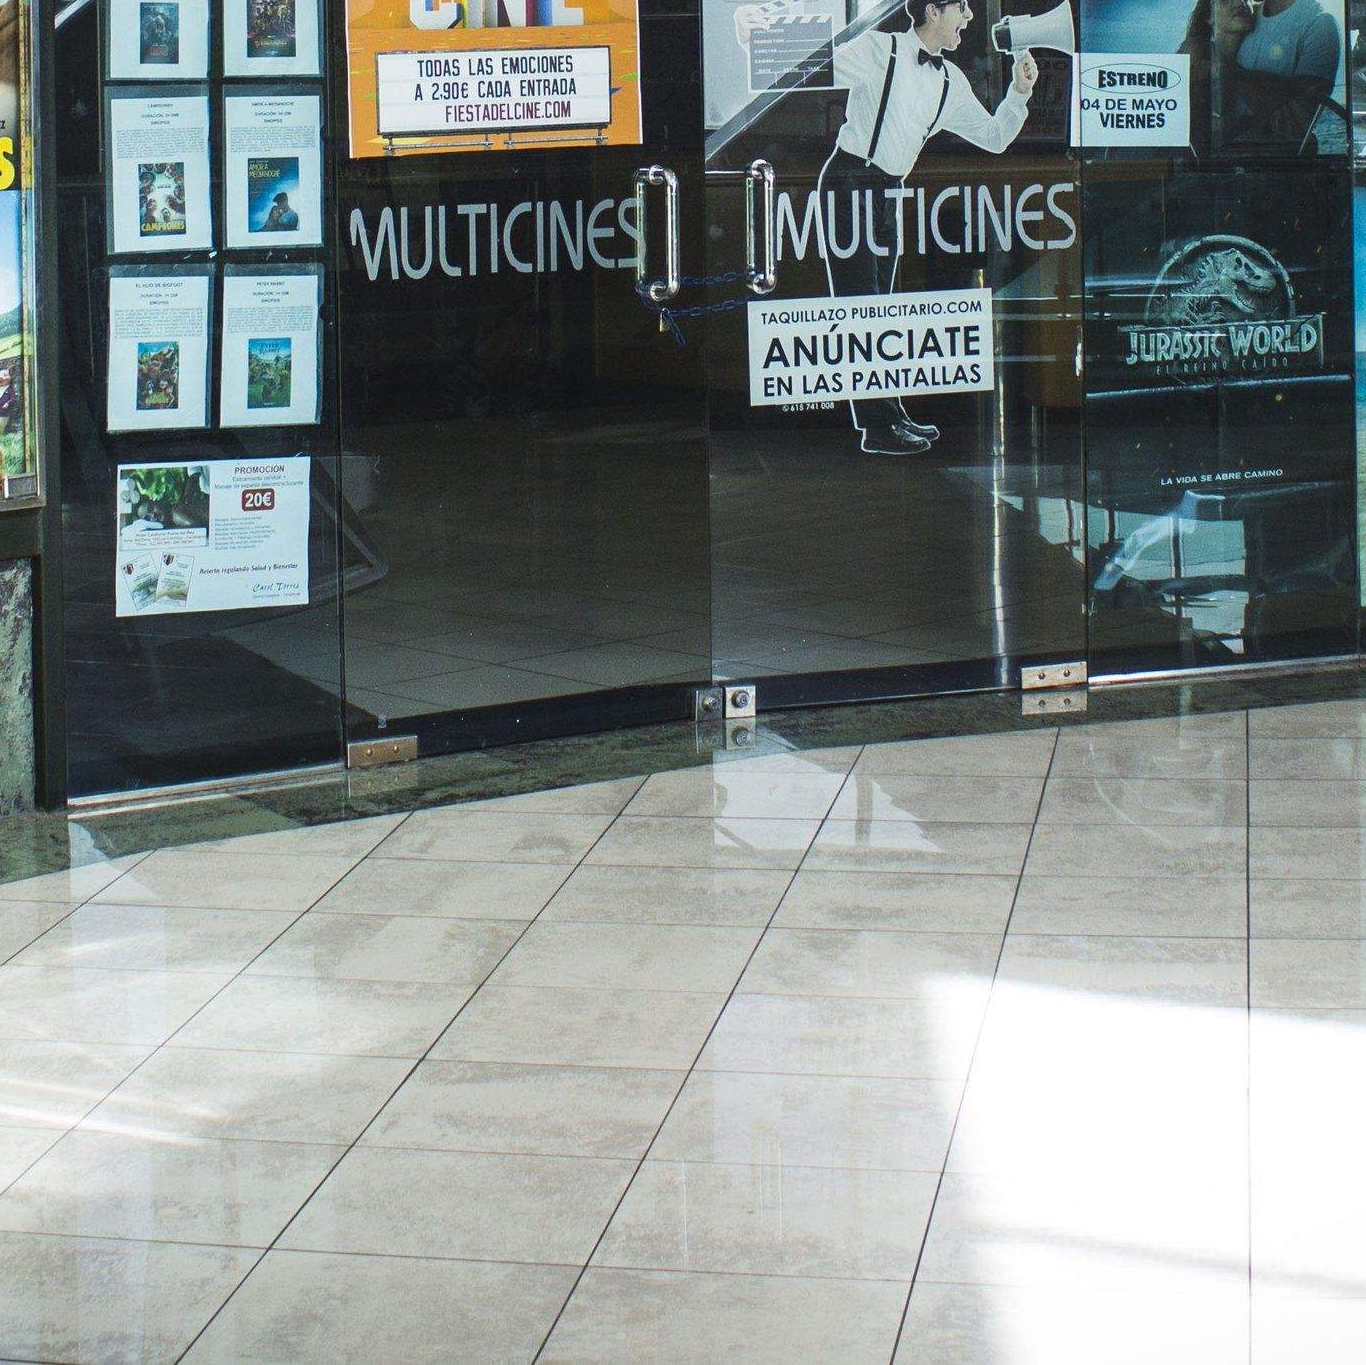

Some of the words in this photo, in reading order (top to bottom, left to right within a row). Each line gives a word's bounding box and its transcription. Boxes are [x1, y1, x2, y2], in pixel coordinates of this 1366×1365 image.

[417, 59, 460, 78] TODAS
[469, 58, 493, 75] LAS
[502, 55, 573, 74] EMOCIONES
[1098, 69, 1168, 88] ESTRENO
[415, 84, 423, 101] A
[478, 81, 511, 98] CADA
[520, 79, 576, 97] ENTRADA
[445, 101, 571, 123] FIESTADELCINE.COM
[1081, 98, 1100, 110] 04
[1105, 99, 1126, 110] DE
[1132, 99, 1177, 110] MAYO
[1100, 112, 1165, 128] VIERNES
[776, 181, 1077, 261] MULTICINES
[350, 198, 645, 281] MULTICINES
[762, 309, 846, 325] TAQUILLAZO
[852, 300, 982, 319] PUBLICITARIO.COM
[763, 324, 980, 368] ANÚNCIATE
[1126, 332, 1223, 365] JURASSIC
[1228, 323, 1318, 356] WORLD
[1156, 366, 1170, 375] EL
[1184, 361, 1227, 372] REINO
[764, 376, 792, 397] EN
[803, 373, 843, 395] LAS
[852, 363, 982, 391] PANTALLAS
[235, 464, 285, 475] PROMOCIÓN
[1176, 475, 1197, 484] VIDA
[1201, 474, 1213, 482] SE
[1215, 472, 1241, 481] ABRE
[1245, 469, 1283, 479] CAMINO
[245, 492, 273, 508] 20€
